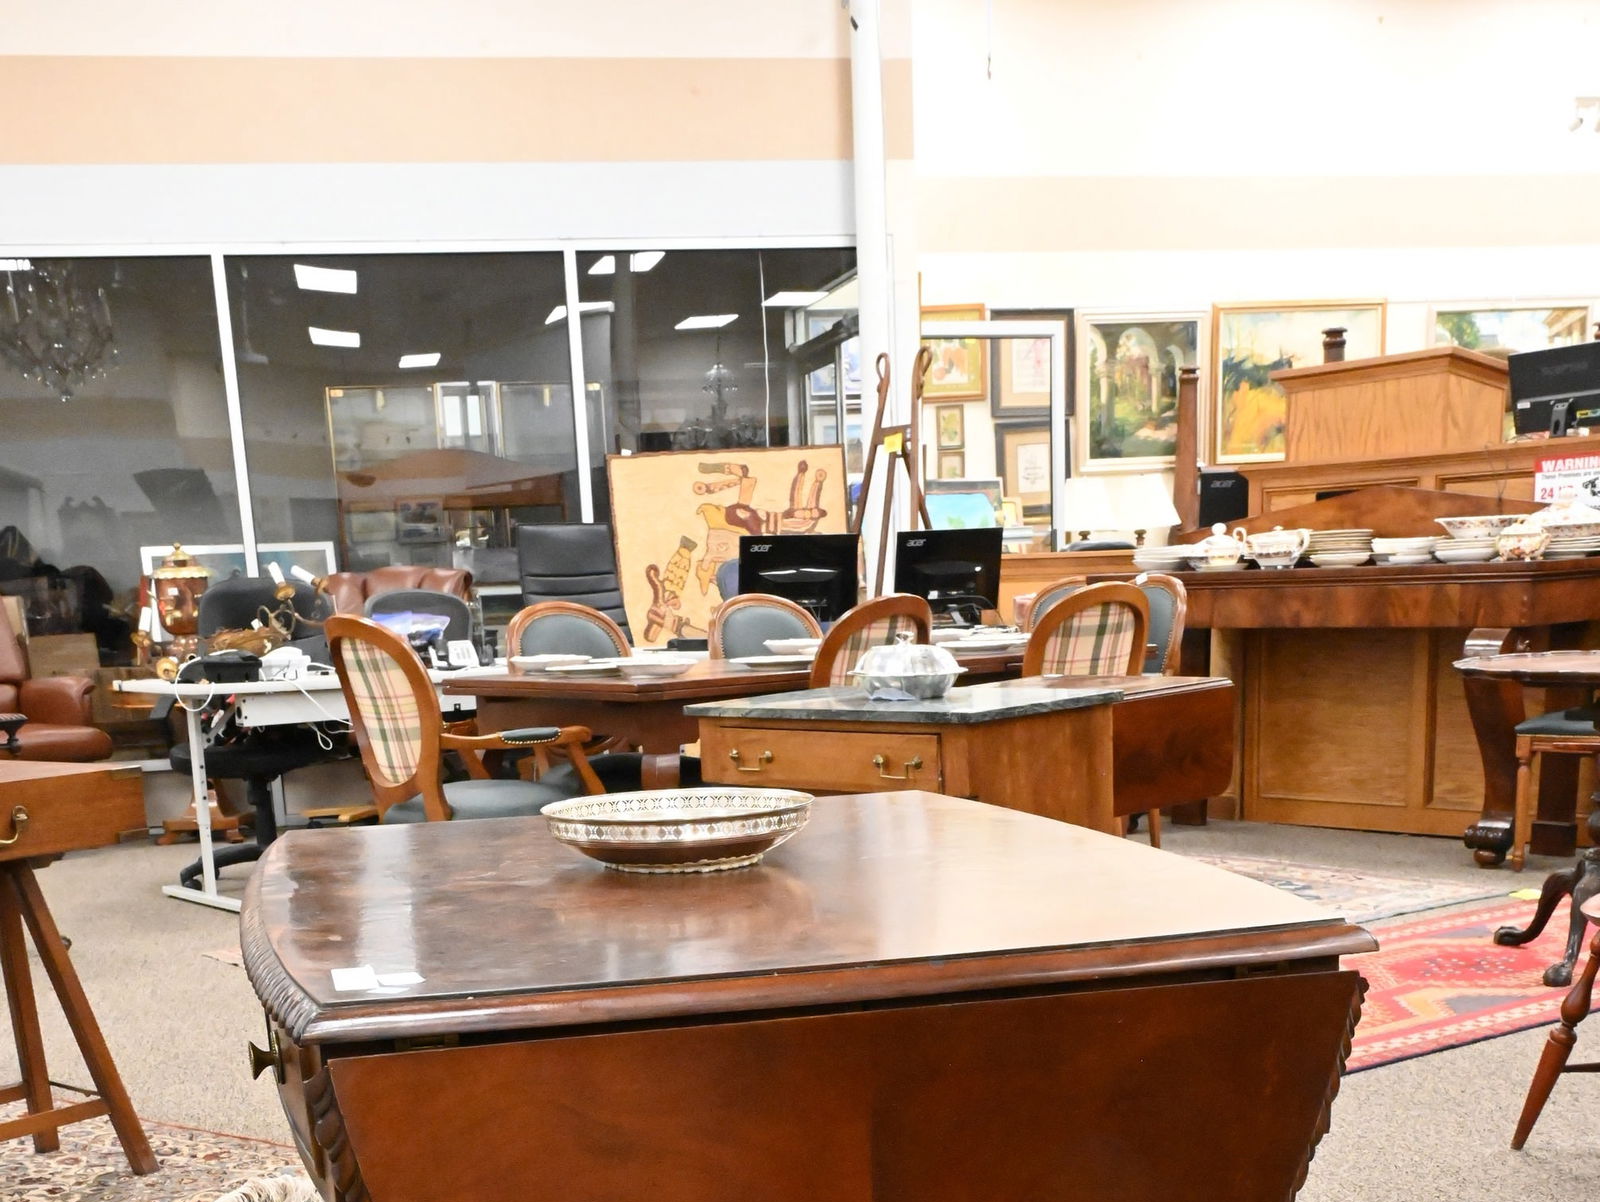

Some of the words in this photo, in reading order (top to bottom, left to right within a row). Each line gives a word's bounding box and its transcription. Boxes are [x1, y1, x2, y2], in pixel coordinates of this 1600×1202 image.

[1541, 456, 1600, 472] WARNIN
[1541, 487, 1554, 500] 24
[906, 538, 926, 546] acer
[750, 544, 772, 552] acer
